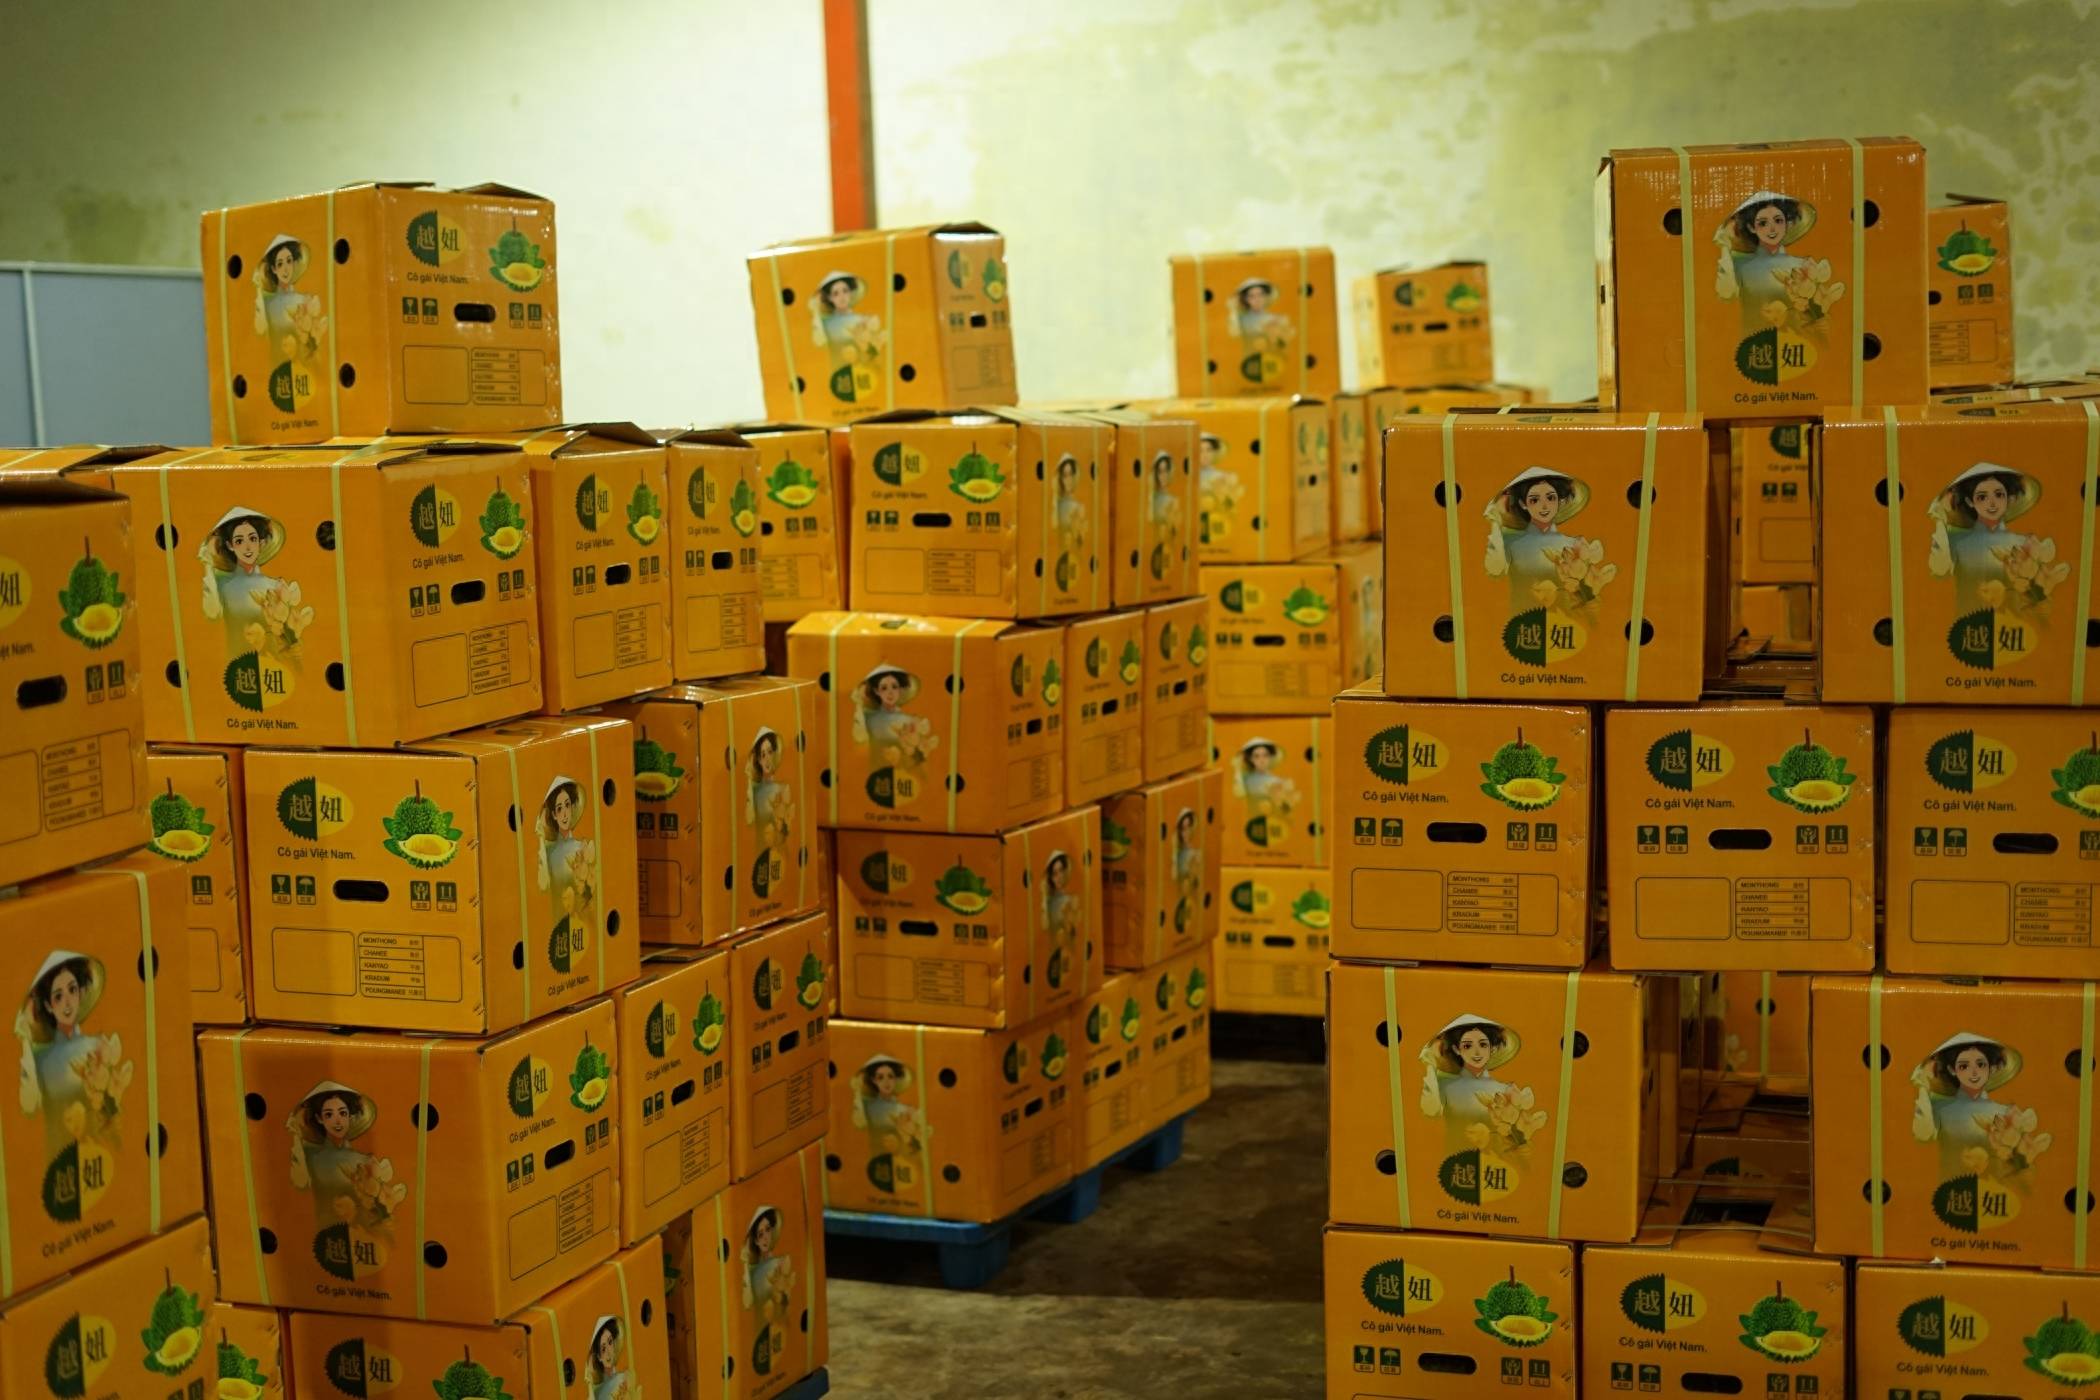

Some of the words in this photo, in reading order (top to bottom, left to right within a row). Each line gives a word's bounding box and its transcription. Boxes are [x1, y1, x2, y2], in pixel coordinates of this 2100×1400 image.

[416, 225, 460, 251] 越妞
[1747, 344, 1808, 369] 越妞
[1735, 393, 1748, 403] Cô
[1751, 393, 1767, 405] gái
[1769, 392, 1790, 404] Việt
[1792, 392, 1819, 401] Nam.
[419, 500, 455, 531] 越妞
[413, 558, 423, 569] Cô
[423, 557, 434, 568] gái
[435, 554, 447, 566] Việt
[448, 553, 465, 564] Nam.
[1515, 624, 1577, 650] 越妞
[1961, 625, 2025, 652] 越妞
[235, 668, 286, 695] 越妞
[1501, 673, 1516, 683] Cô
[1519, 674, 1535, 685] gái
[1537, 674, 1557, 686] Việt
[1560, 675, 1587, 685] Nam.
[1946, 676, 1962, 687] Cô
[1964, 677, 1981, 689] gái
[1984, 677, 2006, 689] Việt
[2008, 678, 2037, 688] Nam.
[227, 719, 240, 729] Cô
[241, 719, 256, 731] gái
[257, 719, 275, 731] Việt
[276, 720, 299, 730] Nam.
[1378, 741, 1438, 769] 越妞
[1660, 747, 1722, 774] 越妞
[1940, 747, 2005, 776] 越妞
[289, 794, 343, 822] 越妞
[1363, 791, 1379, 801] Cô
[1380, 791, 1397, 804] gái
[1400, 792, 1420, 805] Việt
[1422, 793, 1449, 803] Nam.
[1645, 798, 1662, 809] Cô
[1664, 799, 1681, 811] gái
[1684, 799, 1705, 811] Việt
[1707, 799, 1736, 809] Nam.
[1923, 799, 1941, 811] Cô
[1943, 800, 1961, 813] gái
[1963, 800, 1985, 814] Việt
[1987, 801, 2017, 812] Nam.
[277, 847, 292, 858] Cô
[293, 847, 309, 860] gái
[309, 848, 329, 862] Việt
[331, 850, 356, 860] Nam.
[516, 1067, 549, 1106] 越妞
[510, 1131, 519, 1144] Cô
[520, 1128, 529, 1142] gái
[529, 1123, 541, 1137] Việt
[541, 1117, 557, 1131] Nam.
[1451, 1164, 1509, 1192] 越妞
[1946, 1189, 2008, 1217] 越妞
[1437, 1208, 1452, 1219] Cô
[1454, 1211, 1470, 1223] gái
[1472, 1212, 1491, 1224] Việt
[1493, 1214, 1520, 1225] Nam.
[326, 1240, 379, 1266] 越妞
[1930, 1237, 1946, 1248] Cô
[1949, 1239, 1966, 1250] gái
[1969, 1240, 1990, 1251] Việt
[1993, 1241, 2022, 1252] Nam.
[316, 1285, 331, 1295] Cô
[332, 1286, 346, 1297] gái
[347, 1286, 366, 1299] Việt
[368, 1289, 392, 1299] Nam.
[1375, 1274, 1433, 1302] 越妞
[1634, 1289, 1696, 1318] 越妞
[1361, 1320, 1377, 1332] Cô
[1378, 1321, 1395, 1334] gái
[1396, 1323, 1417, 1335] Việt
[1419, 1326, 1445, 1336] Nam.
[1912, 1312, 1976, 1341] 越妞
[1619, 1336, 1635, 1348] Cô
[1637, 1339, 1654, 1351] gái
[1657, 1340, 1678, 1352] Việt
[1679, 1342, 1708, 1353] Nam.
[337, 1356, 393, 1383] 越妞
[1897, 1362, 1913, 1373] Cô
[1916, 1364, 1933, 1375] gái
[1936, 1364, 1958, 1376] Việt
[1960, 1366, 1990, 1377] Nam.
